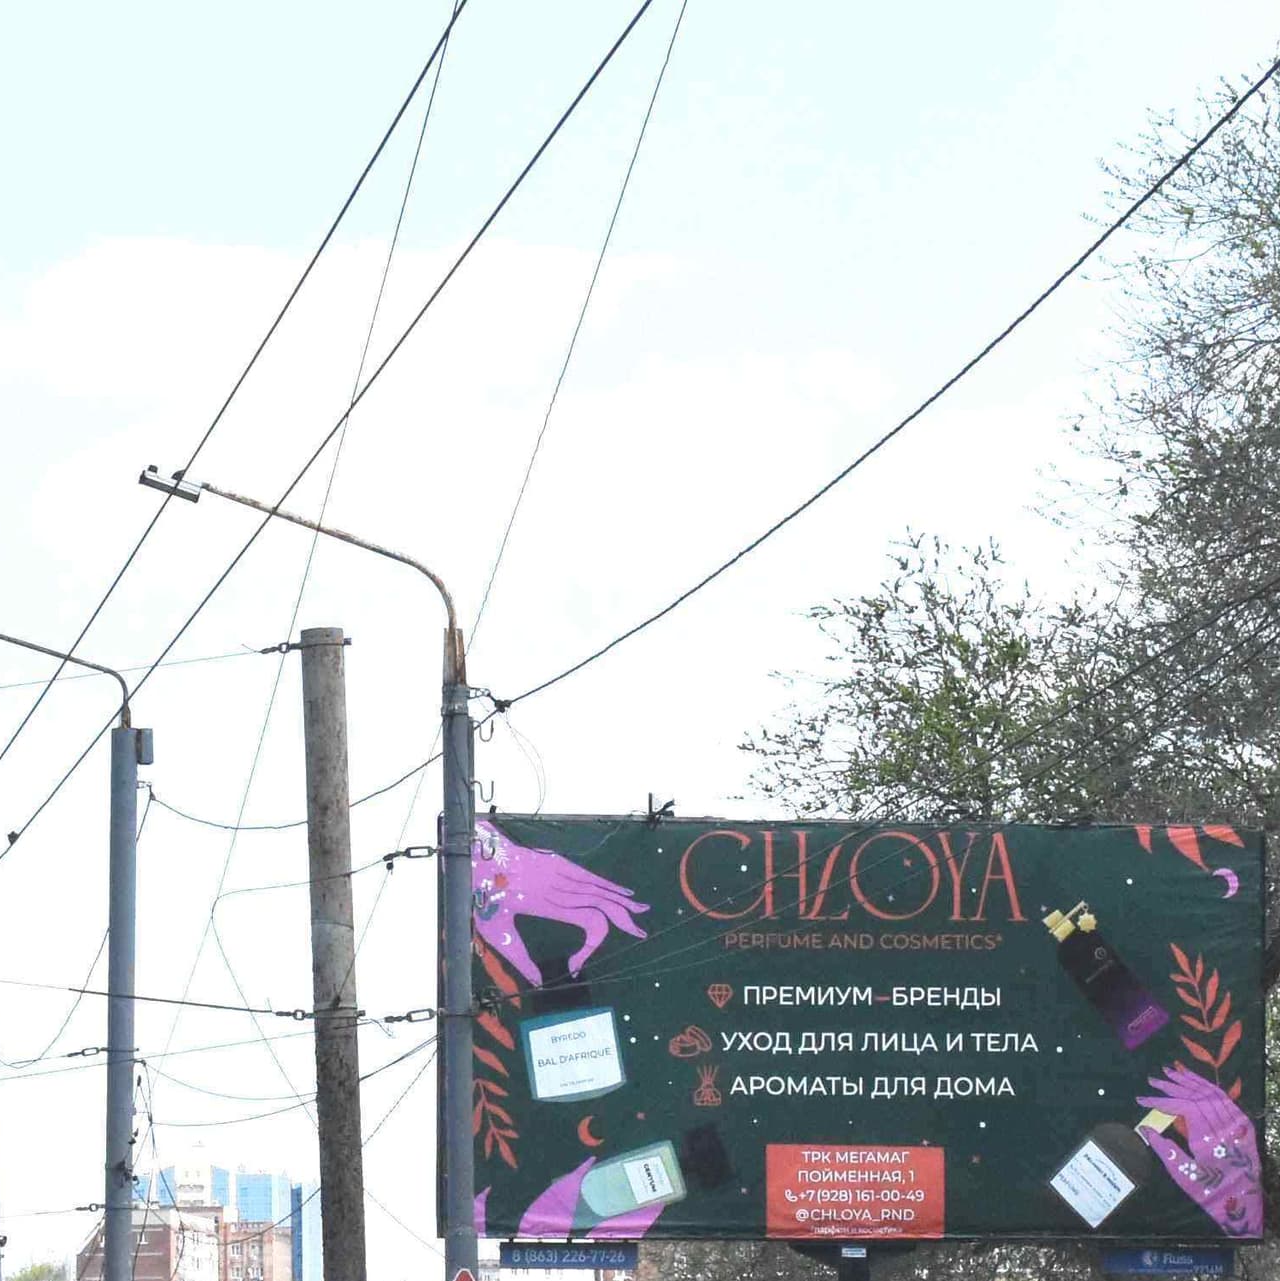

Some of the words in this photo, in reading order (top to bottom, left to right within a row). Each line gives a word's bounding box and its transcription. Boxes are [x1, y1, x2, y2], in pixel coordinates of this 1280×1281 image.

[680, 831, 1028, 921] CHLOYA
[725, 934, 820, 949] PERFUME
[828, 934, 874, 949] AND
[551, 1032, 586, 1044] BYREDO
[720, 1032, 792, 1054] УХОД
[798, 1032, 853, 1054] ДЛЯ
[861, 1032, 938, 1055] ЛИЦА
[947, 1033, 963, 1052] И
[970, 1033, 1038, 1052] ТЕЛА
[538, 1059, 557, 1068] BAL
[730, 1076, 863, 1096] АРОМАТЫ
[871, 1077, 926, 1099] ДЛЯ
[934, 1077, 1015, 1099] ДОМА
[802, 1151, 831, 1163] ТРК
[836, 1151, 910, 1163] МЕГАМАГ
[798, 1169, 906, 1184] ПОЙМЕННАЯ,
[909, 1171, 915, 1182] 1
[856, 1190, 924, 1202] 161-00-49
[796, 1209, 915, 1222] @CHLOYA_RND
[512, 1250, 520, 1262] 8
[525, 1249, 558, 1264] (863)
[562, 1250, 625, 1262] 226-77-26
